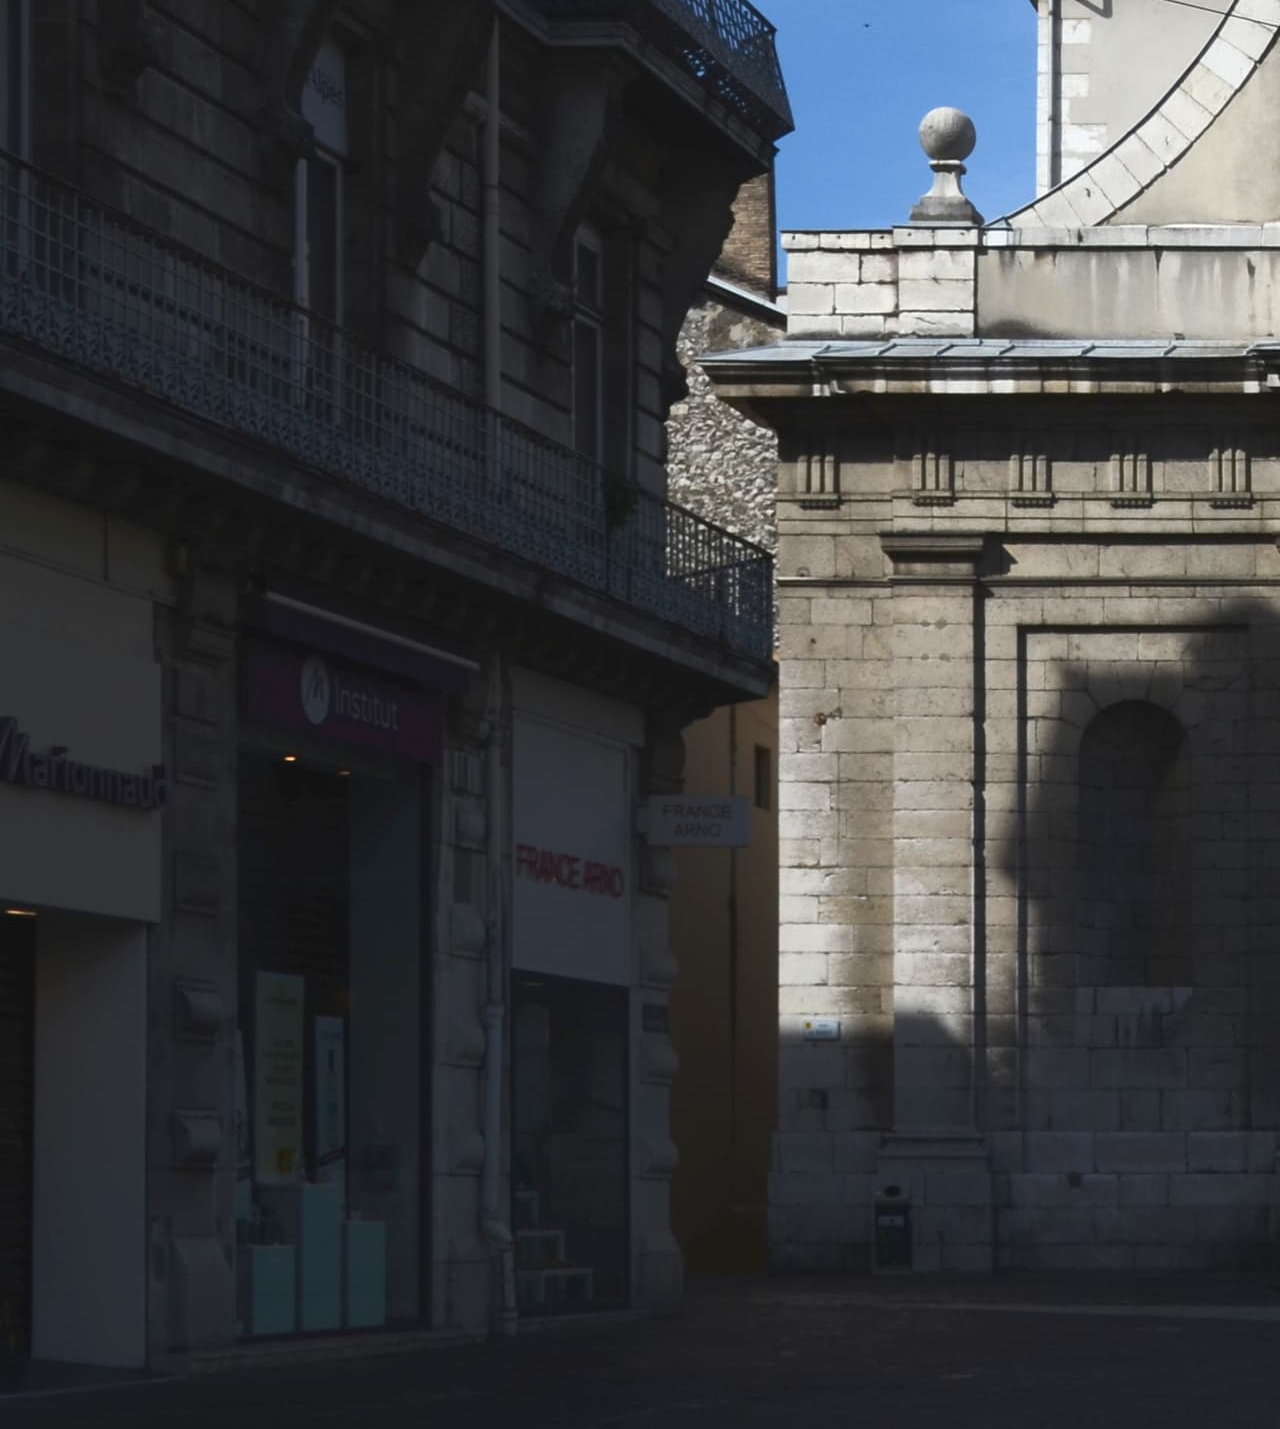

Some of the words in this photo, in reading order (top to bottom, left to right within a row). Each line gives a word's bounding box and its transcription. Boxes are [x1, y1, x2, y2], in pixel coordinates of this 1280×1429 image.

[334, 672, 400, 731] Institut
[661, 802, 733, 820] FRANCE
[672, 822, 722, 839] ARNO
[515, 843, 581, 890] FRANCE
[583, 860, 625, 899] ARNO
